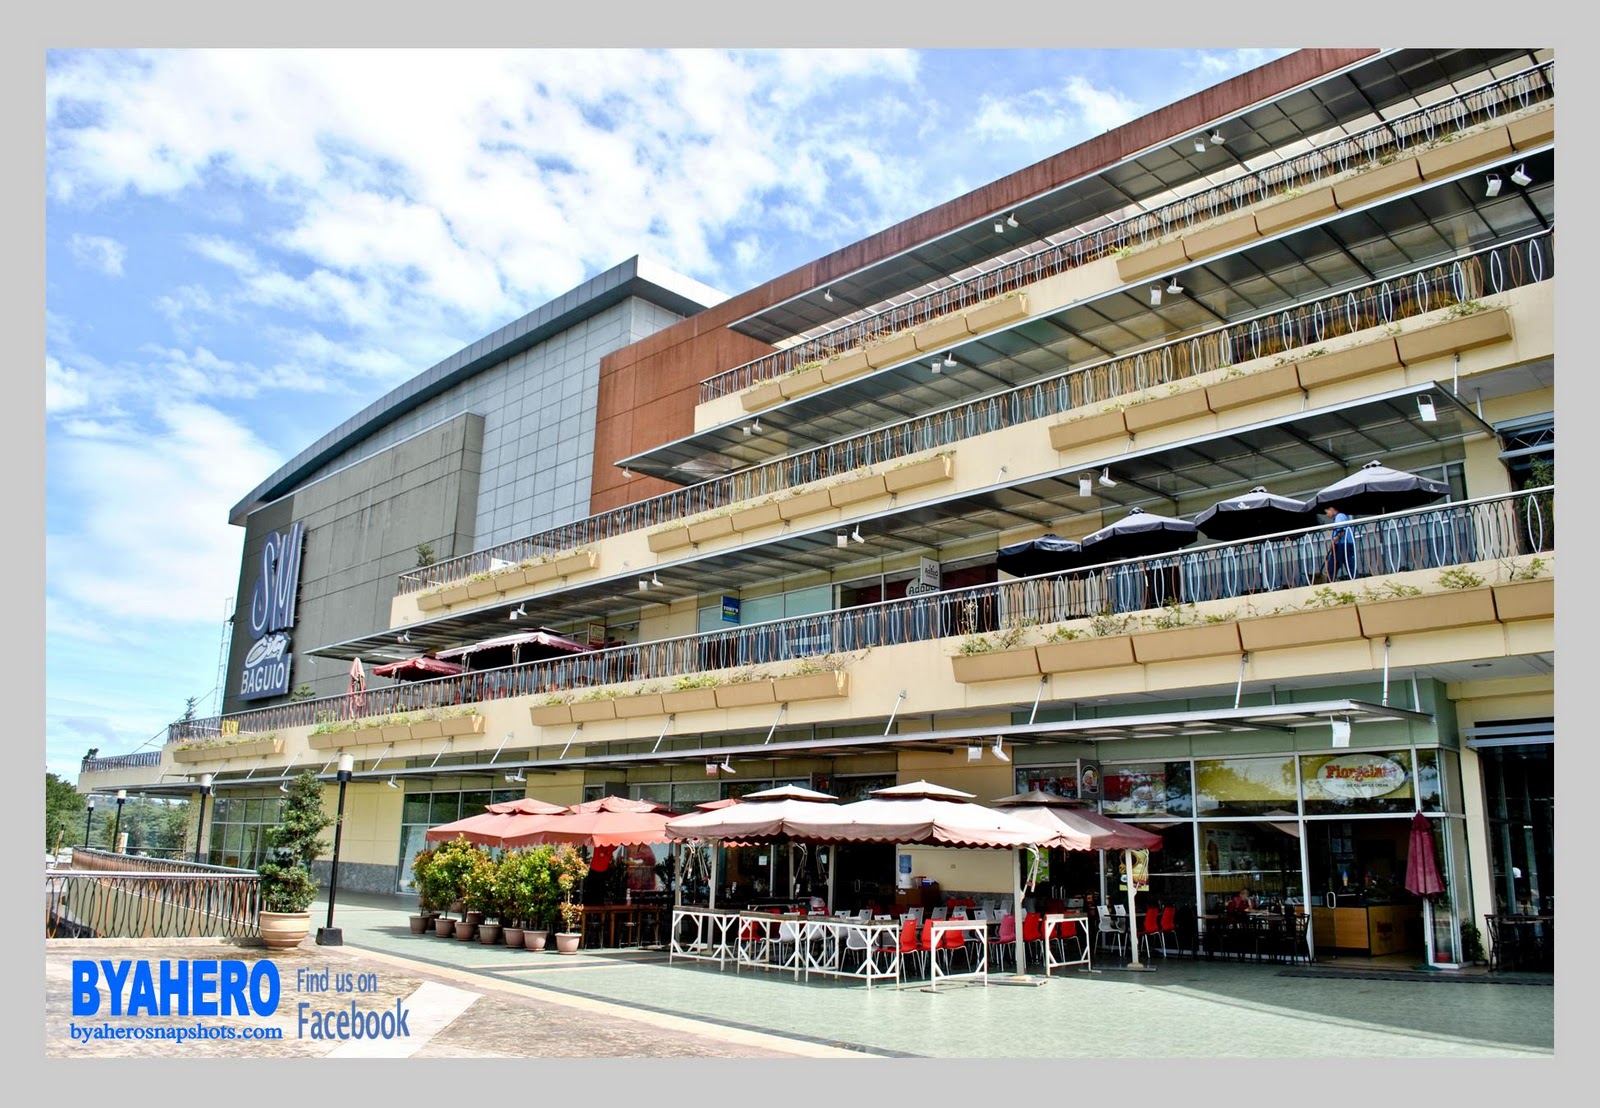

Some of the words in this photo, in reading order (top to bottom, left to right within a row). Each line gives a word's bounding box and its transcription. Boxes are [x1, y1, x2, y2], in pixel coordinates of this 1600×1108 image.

[250, 521, 302, 638] SM
[244, 633, 287, 668] City
[240, 662, 285, 695] BAGUIO
